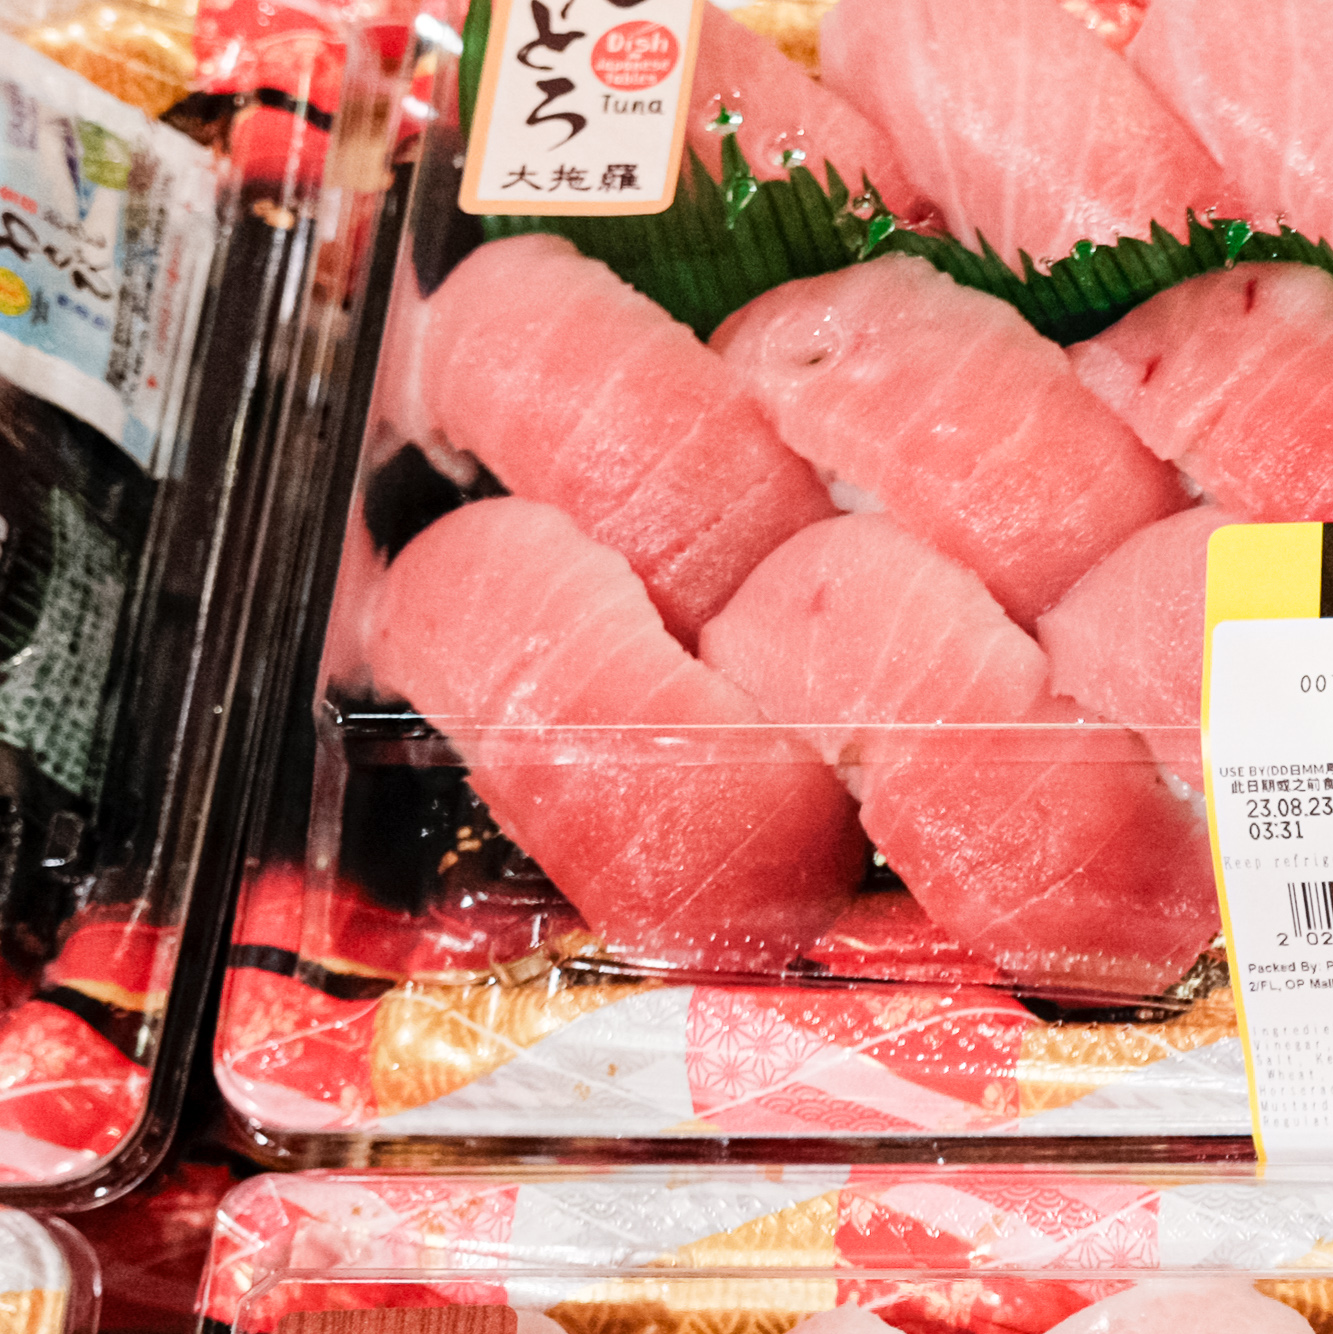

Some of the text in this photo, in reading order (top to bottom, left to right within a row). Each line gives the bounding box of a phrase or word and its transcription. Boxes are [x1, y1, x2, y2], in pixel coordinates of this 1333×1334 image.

[606, 31, 670, 53] Dish
[601, 94, 664, 116] Tuna
[1219, 766, 1245, 778] USE
[1246, 796, 1333, 819] 23.08.23
[1248, 820, 1304, 841] 03:31
[1276, 932, 1289, 947] 2
[1248, 961, 1297, 974] Packed
[1300, 960, 1323, 975] By:
